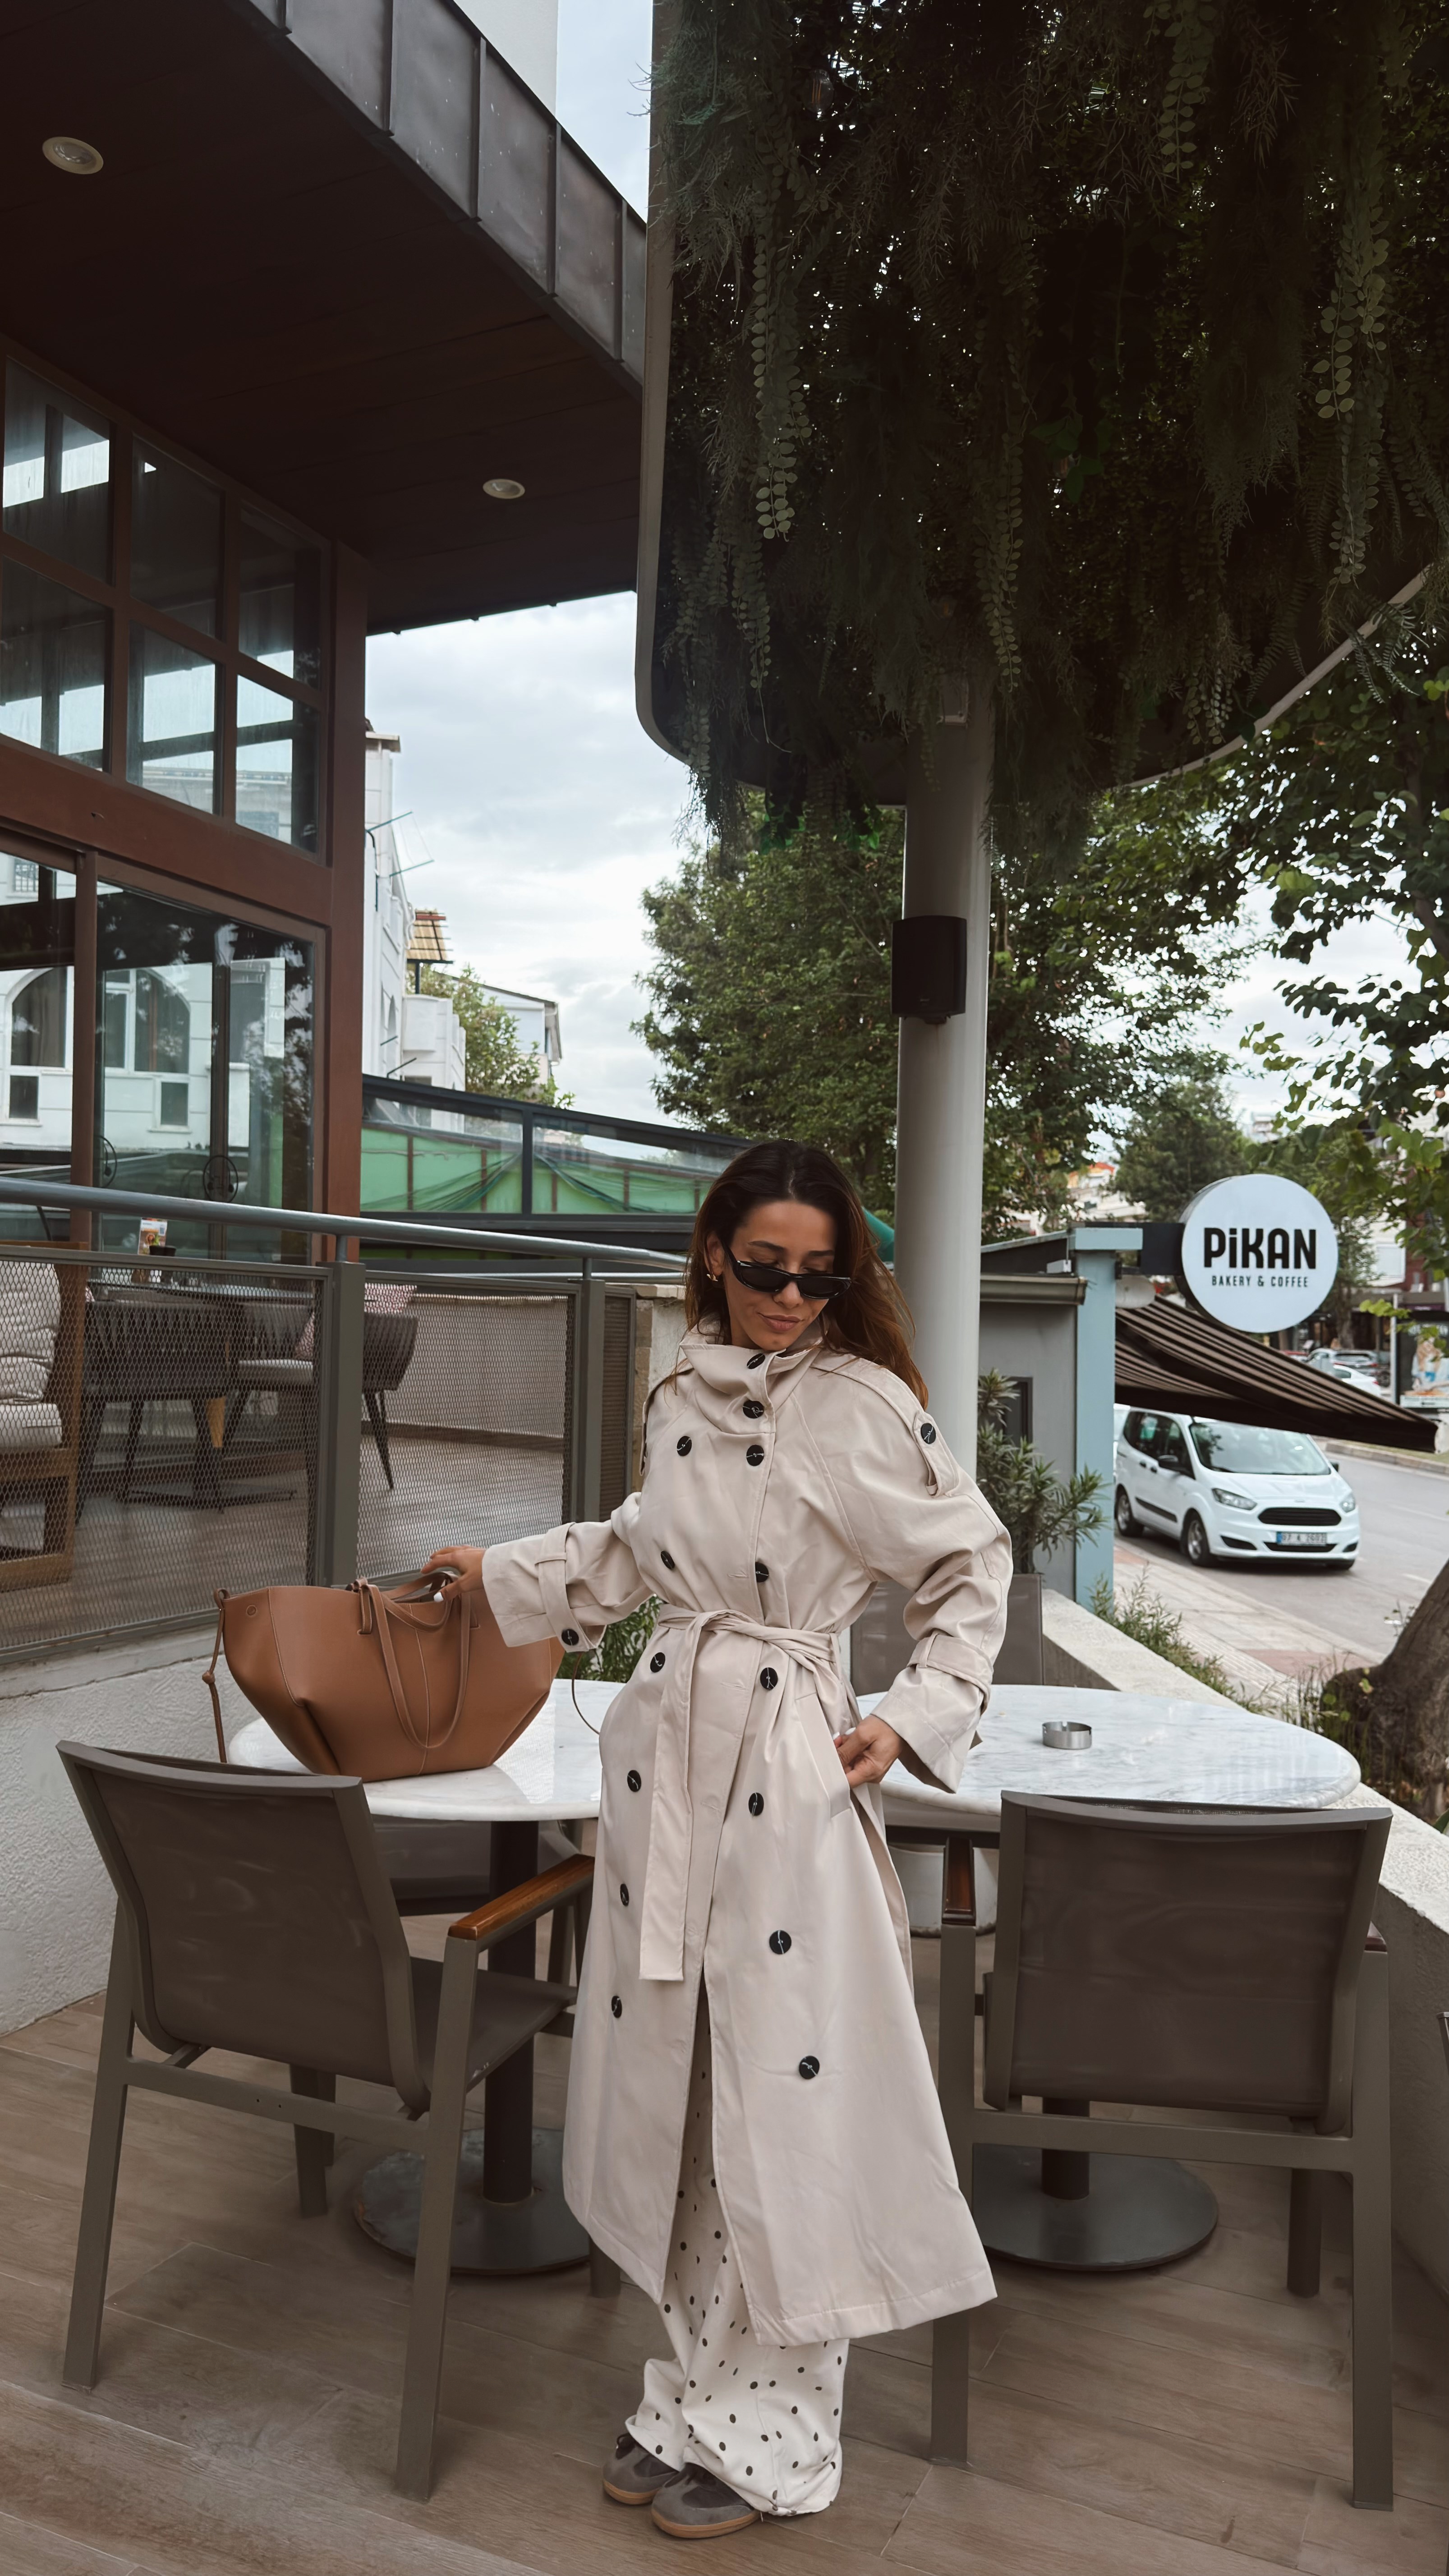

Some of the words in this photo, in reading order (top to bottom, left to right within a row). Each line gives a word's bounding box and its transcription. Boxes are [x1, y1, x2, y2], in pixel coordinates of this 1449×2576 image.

[1211, 1275, 1251, 1286] BAKERY
[1257, 1275, 1265, 1287] &
[1270, 1276, 1308, 1288] COFFEE
